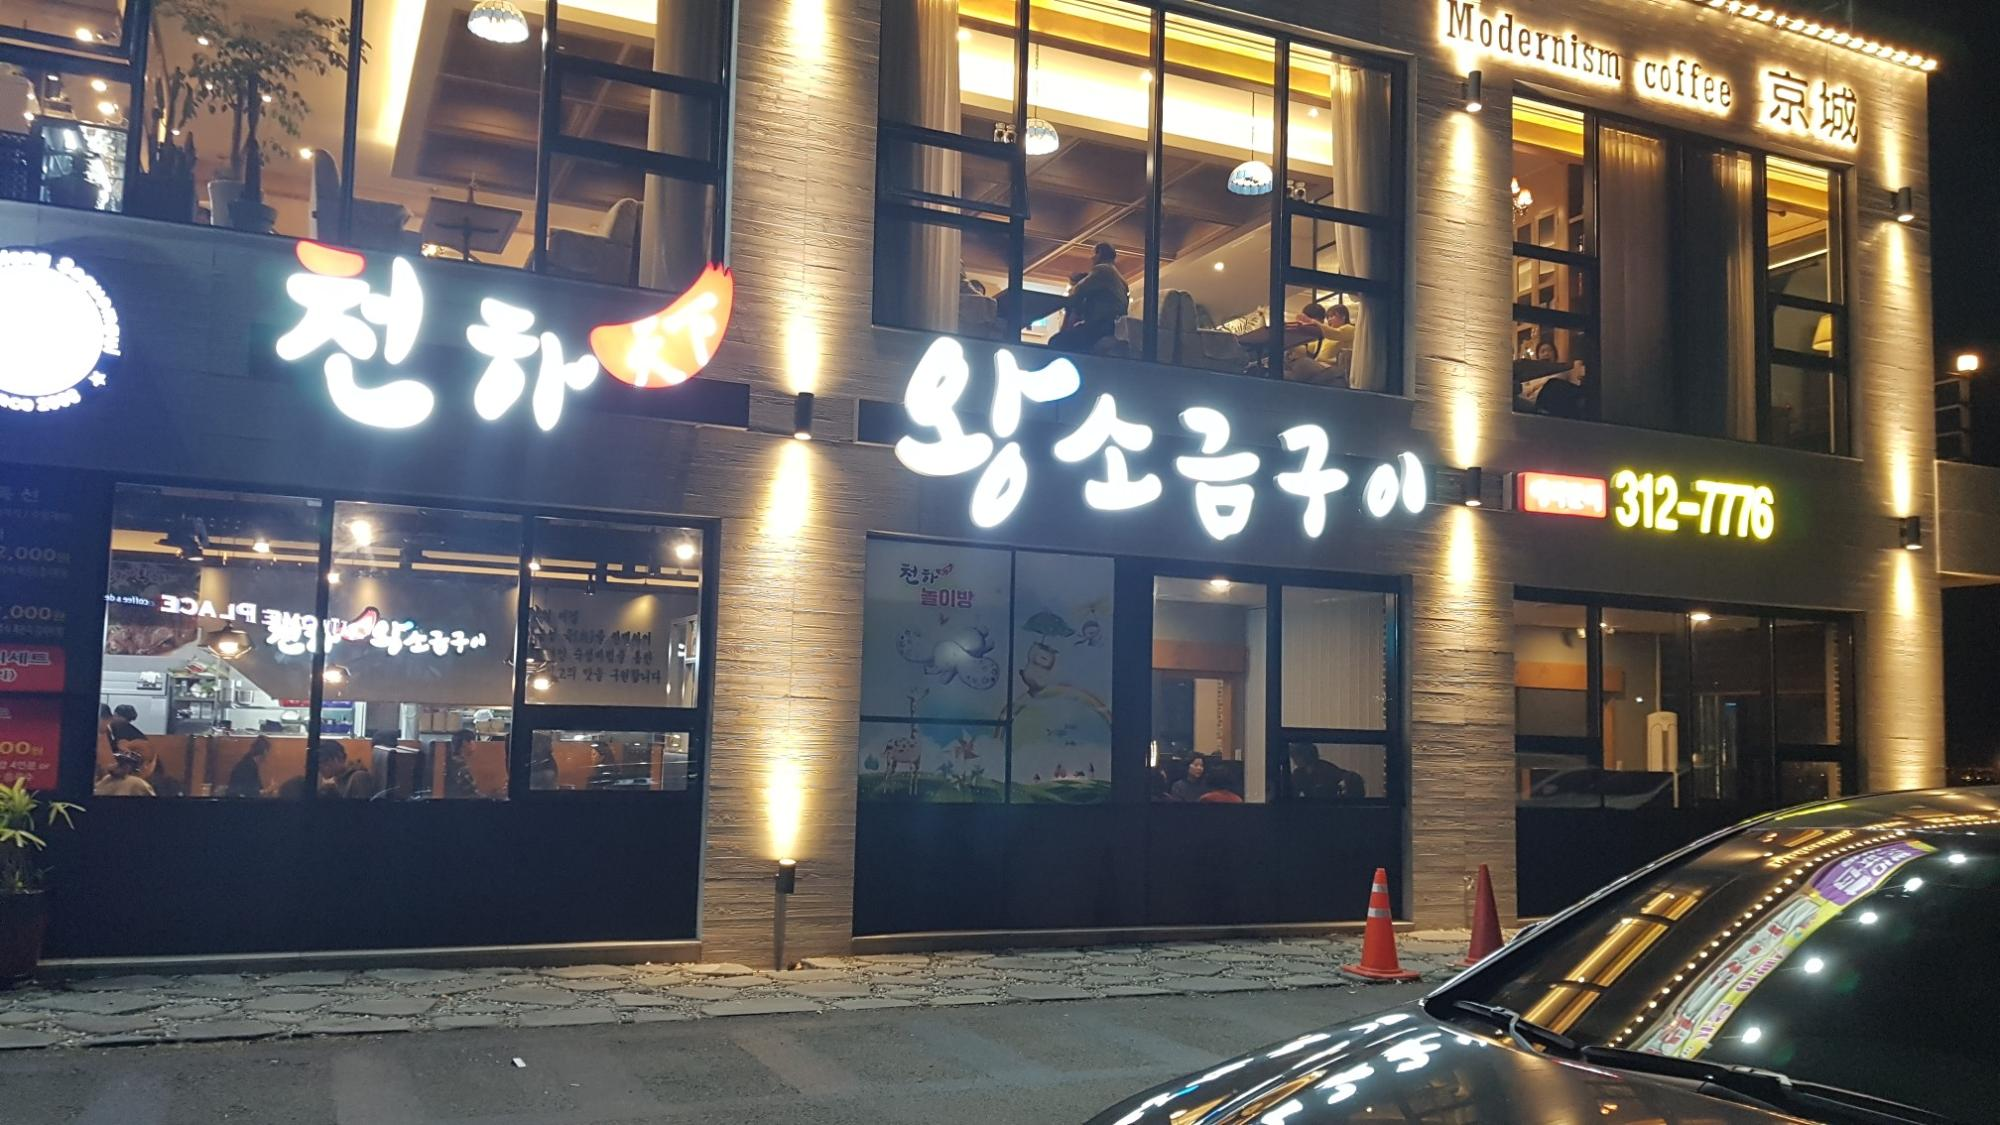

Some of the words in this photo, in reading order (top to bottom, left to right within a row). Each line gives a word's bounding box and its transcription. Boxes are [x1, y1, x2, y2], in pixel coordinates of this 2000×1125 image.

[1446, 0, 1621, 81] Modernism
[1643, 60, 1733, 109] coffee
[1766, 69, 1860, 144] 京城
[276, 240, 600, 432] 천하
[1613, 470, 1775, 540] 312-7776
[920, 587, 975, 609] 놀이방
